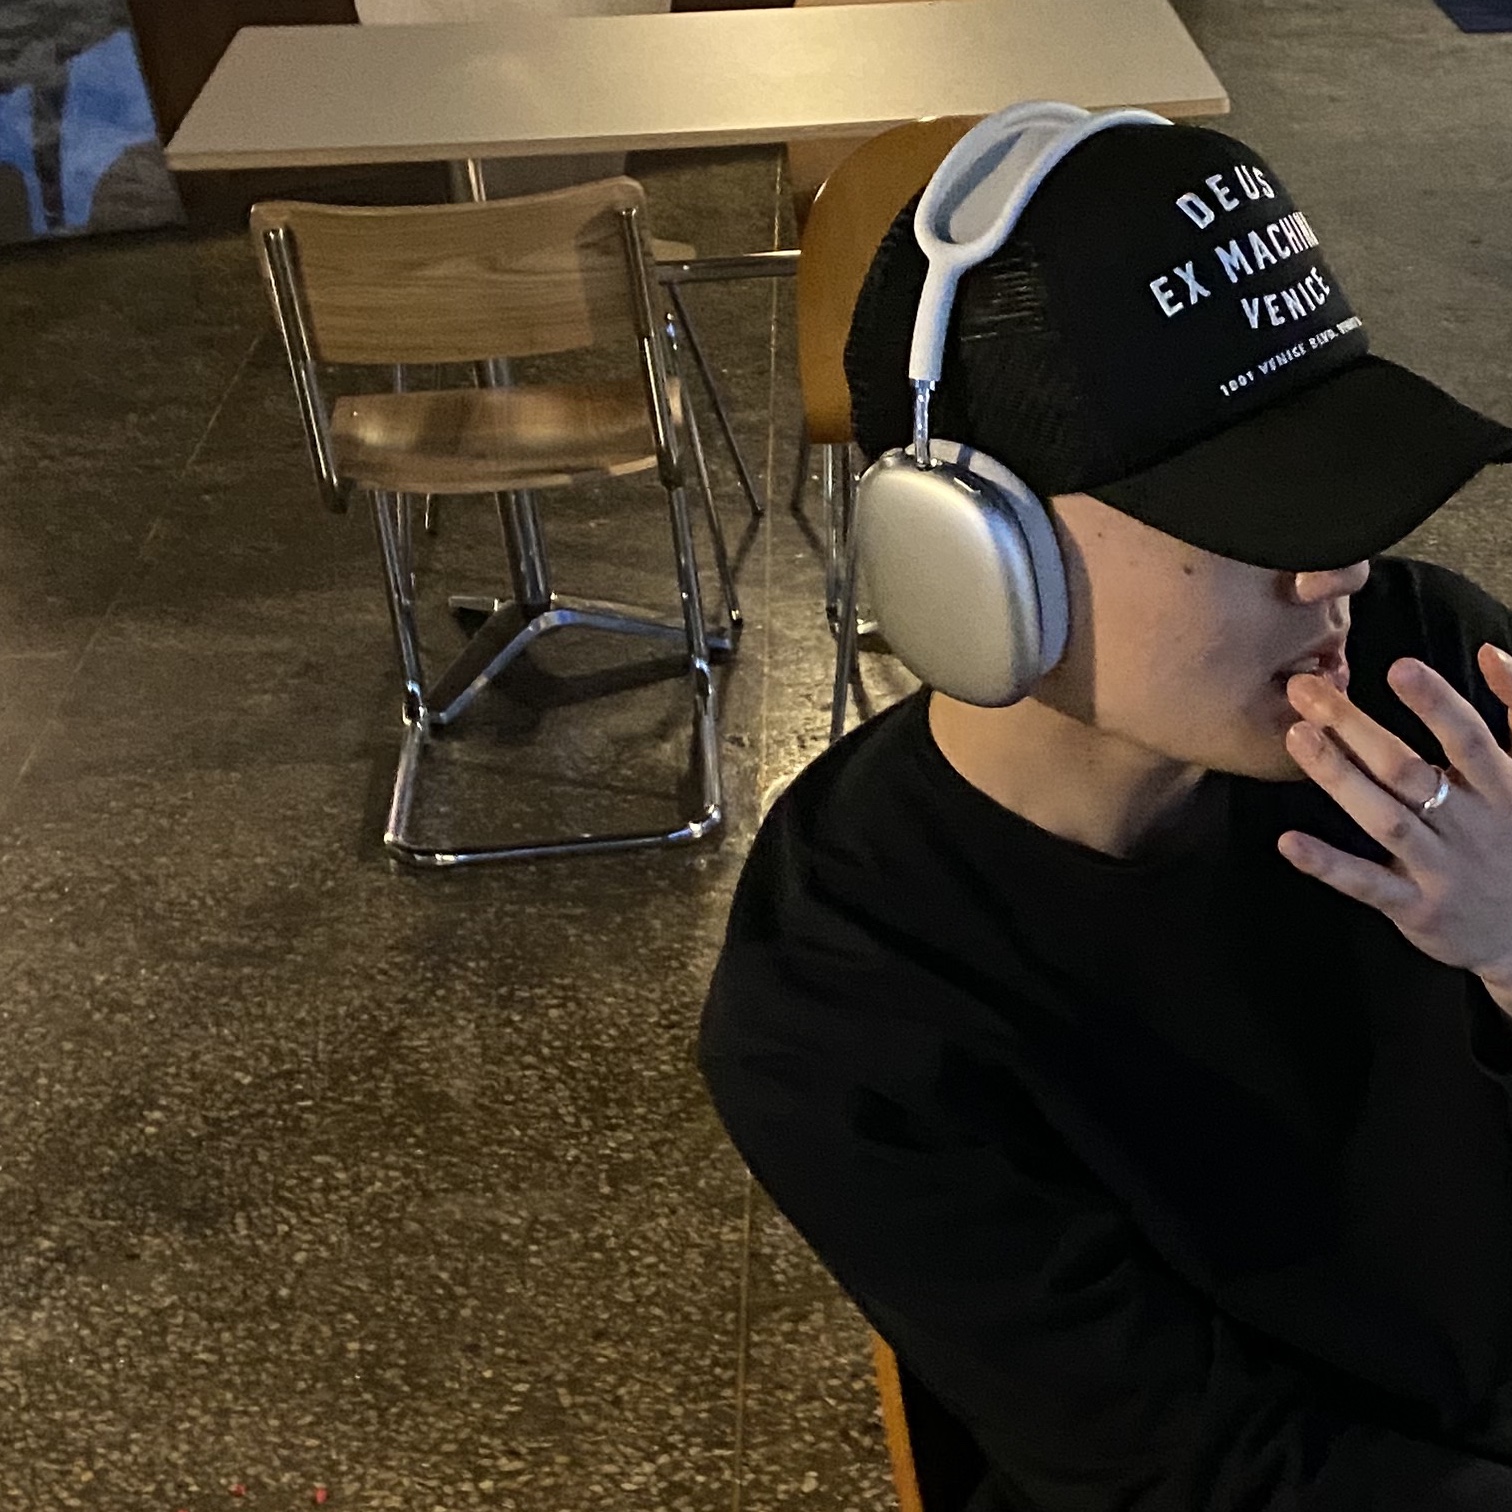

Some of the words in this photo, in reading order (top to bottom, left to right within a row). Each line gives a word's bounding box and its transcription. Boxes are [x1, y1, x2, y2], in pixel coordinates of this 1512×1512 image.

[1176, 164, 1275, 229] DEUS
[1149, 261, 1211, 317] EX
[1215, 211, 1320, 283] MACHIN
[1240, 266, 1330, 329] VENICE
[1220, 371, 1254, 396] 1001
